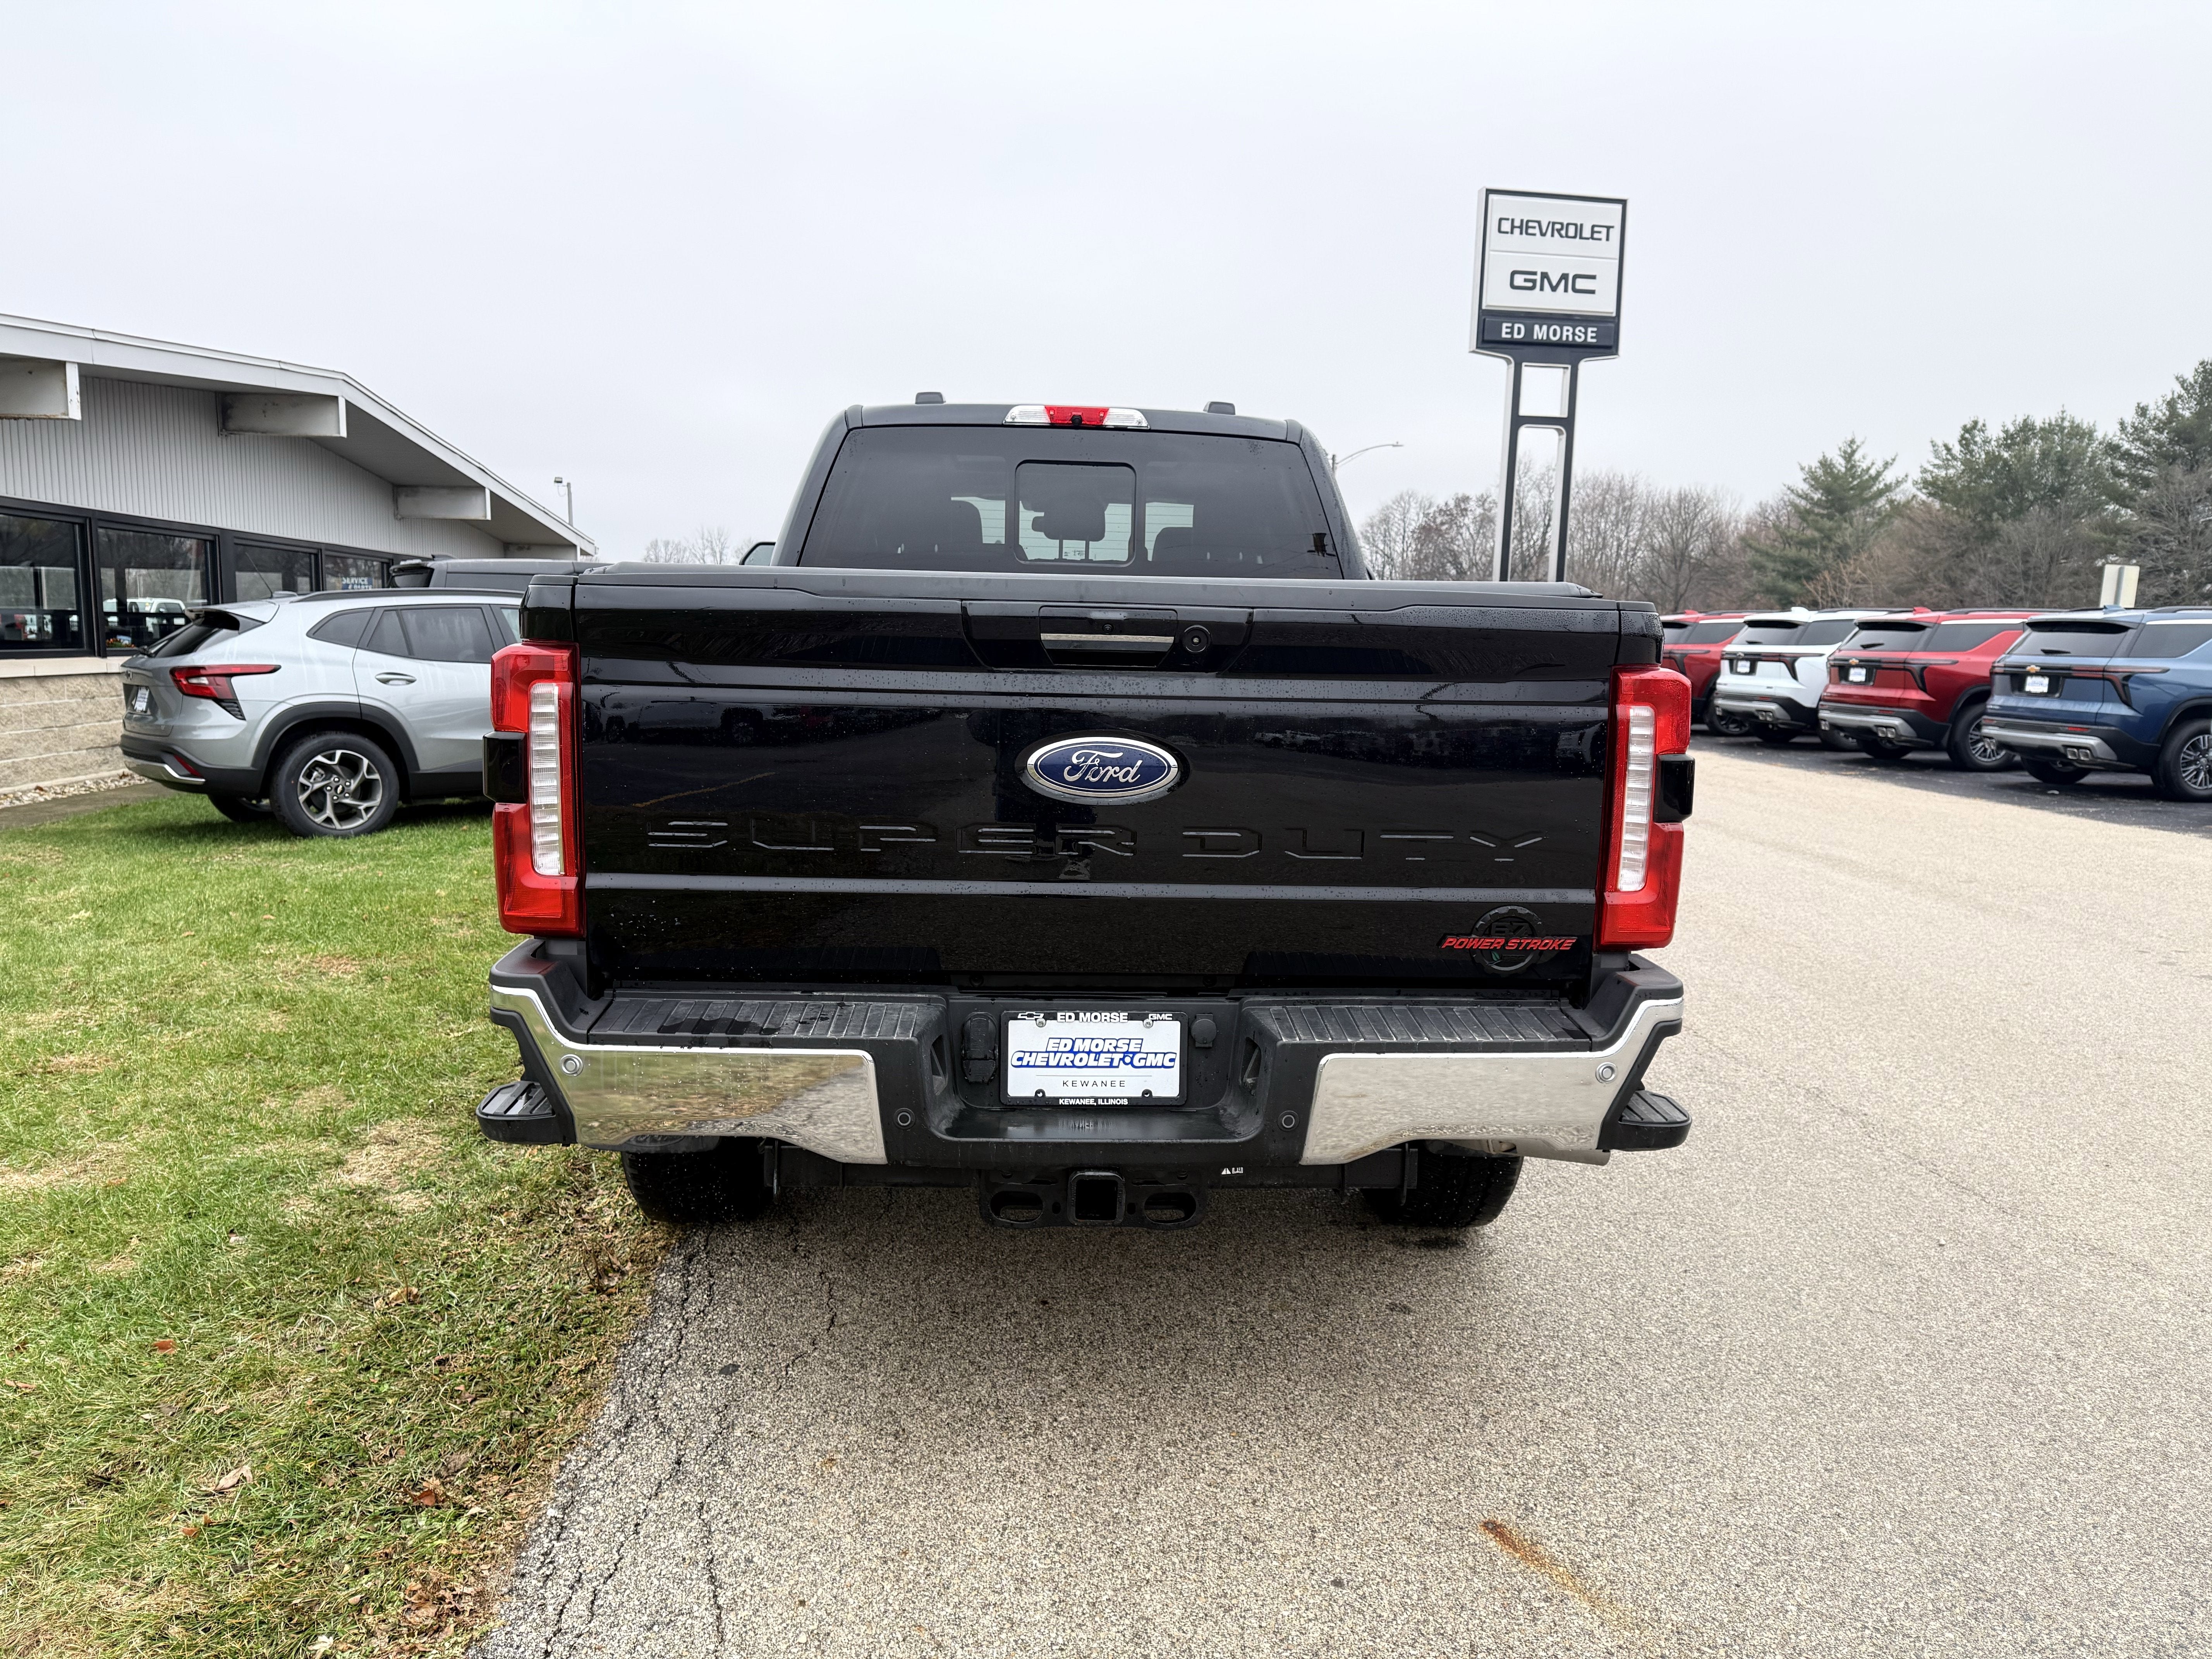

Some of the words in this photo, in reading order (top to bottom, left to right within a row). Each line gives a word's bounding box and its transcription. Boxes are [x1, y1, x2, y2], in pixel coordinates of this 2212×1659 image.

[1497, 217, 1615, 242] CHEVROLET
[1510, 270, 1597, 295] GMC
[1501, 323, 1525, 339] ED
[1533, 324, 1597, 343] MORSE
[1063, 749, 1143, 783] Ford
[647, 818, 1137, 857] SUPER
[1182, 826, 1544, 862] DUTY
[1441, 937, 1506, 950] POWER
[1505, 938, 1578, 950] STROKE
[1057, 1012, 1075, 1023] ED
[1079, 1012, 1128, 1023] MORSE
[1046, 1038, 1073, 1052] ED
[1072, 1039, 1143, 1053] MORSE
